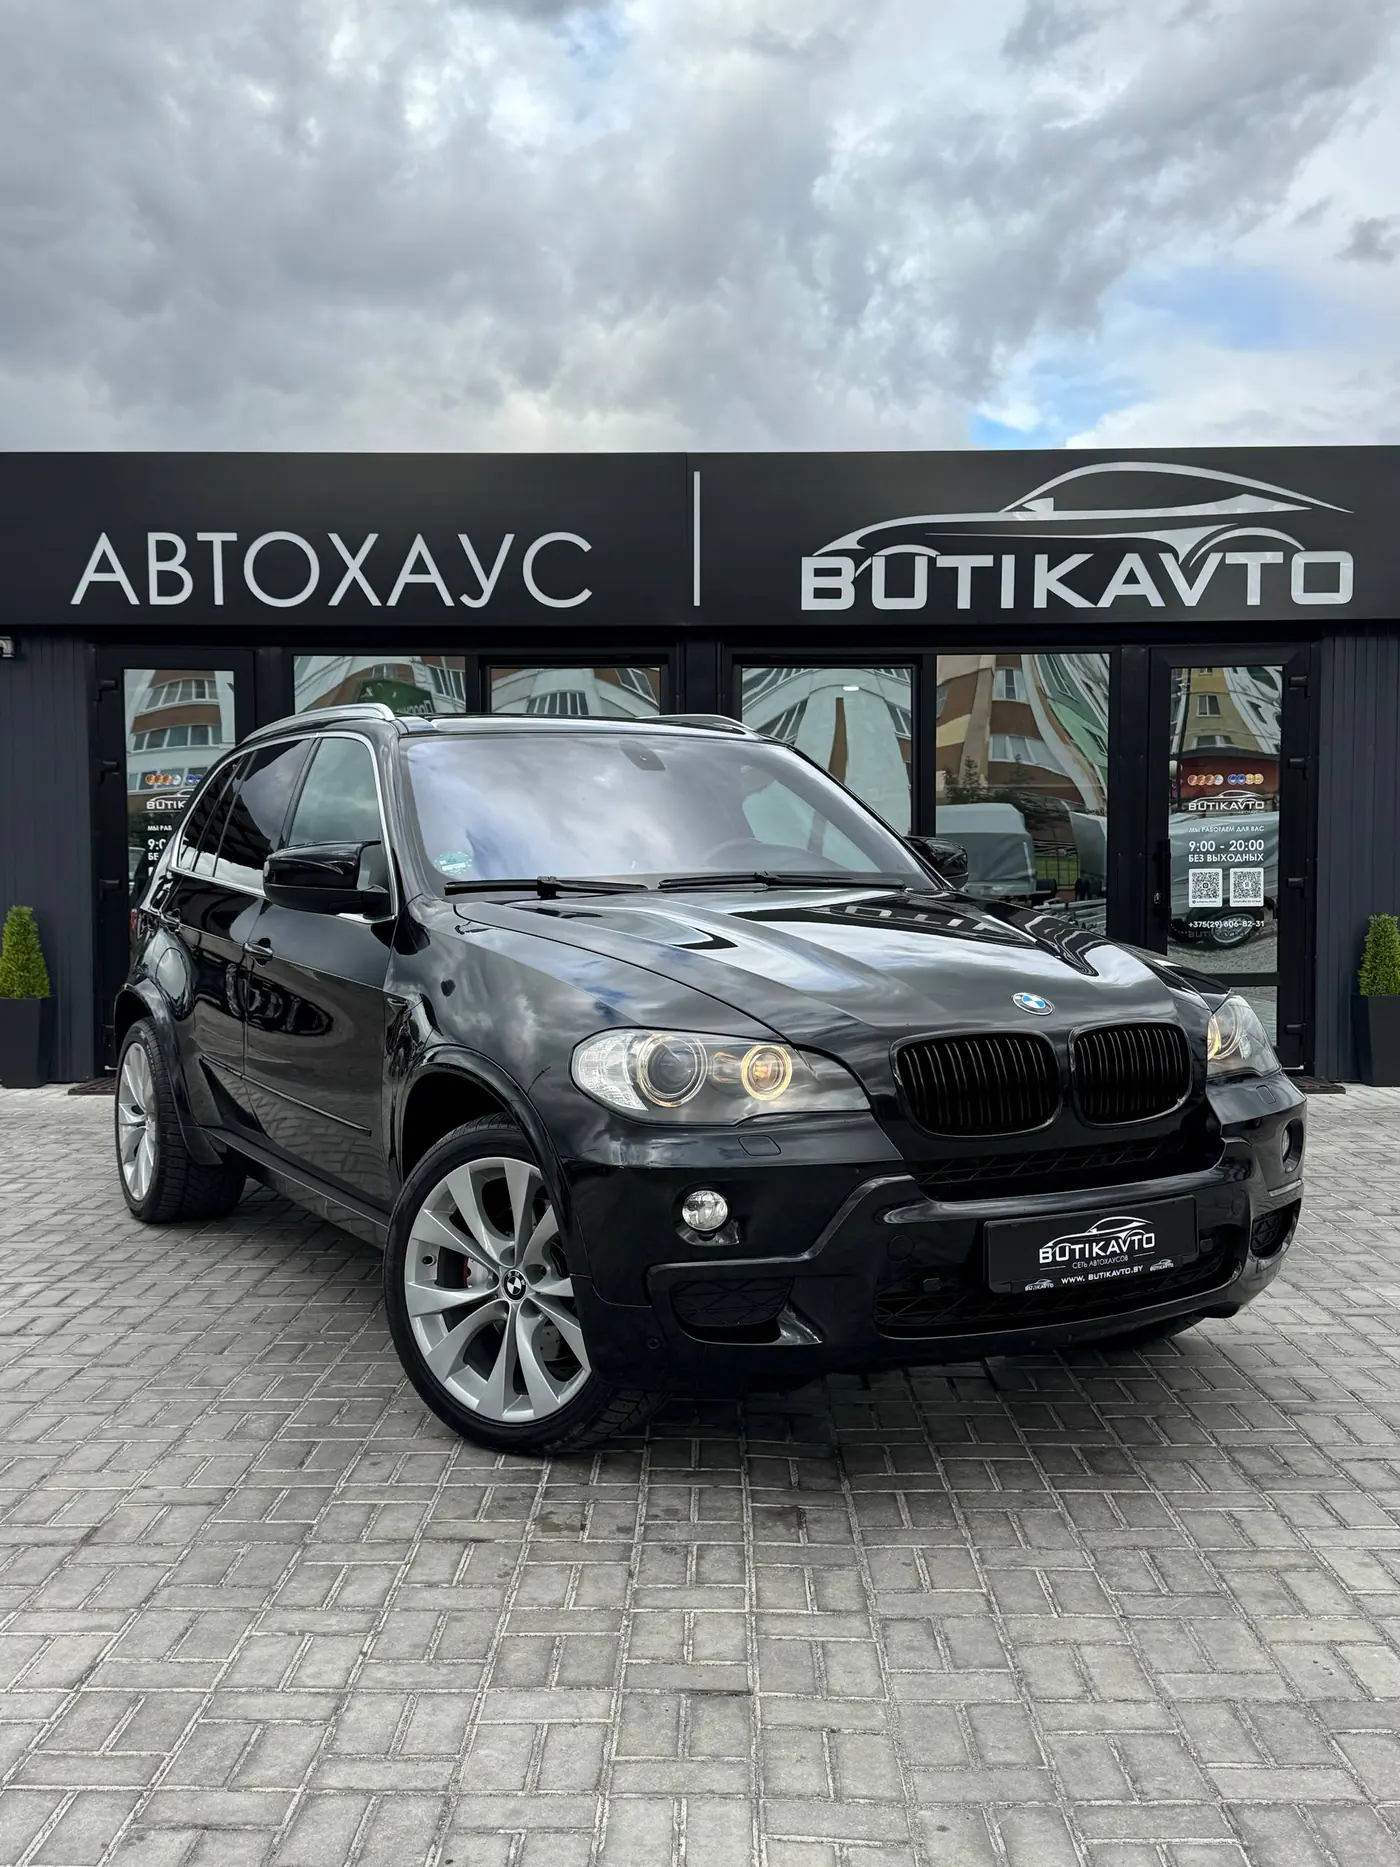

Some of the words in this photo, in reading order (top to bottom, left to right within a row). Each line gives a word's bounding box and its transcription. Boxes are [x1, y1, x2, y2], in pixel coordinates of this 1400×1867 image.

[70, 531, 593, 609] АВТОХАУС
[801, 550, 1354, 611] BUTIKAVTO
[1188, 801, 1265, 811] BUTIKAVTO
[1188, 840, 1216, 852] 9:00
[1229, 839, 1265, 852] 20:00
[1188, 854, 1205, 863] БЕЗ
[1206, 853, 1264, 863] ВЫХОДНЫХ
[1039, 1233, 1155, 1263] BUTIKAVTO
[1072, 1261, 1088, 1270] СЕТЬ
[1089, 1254, 1129, 1267] АВТОХАУСОВ
